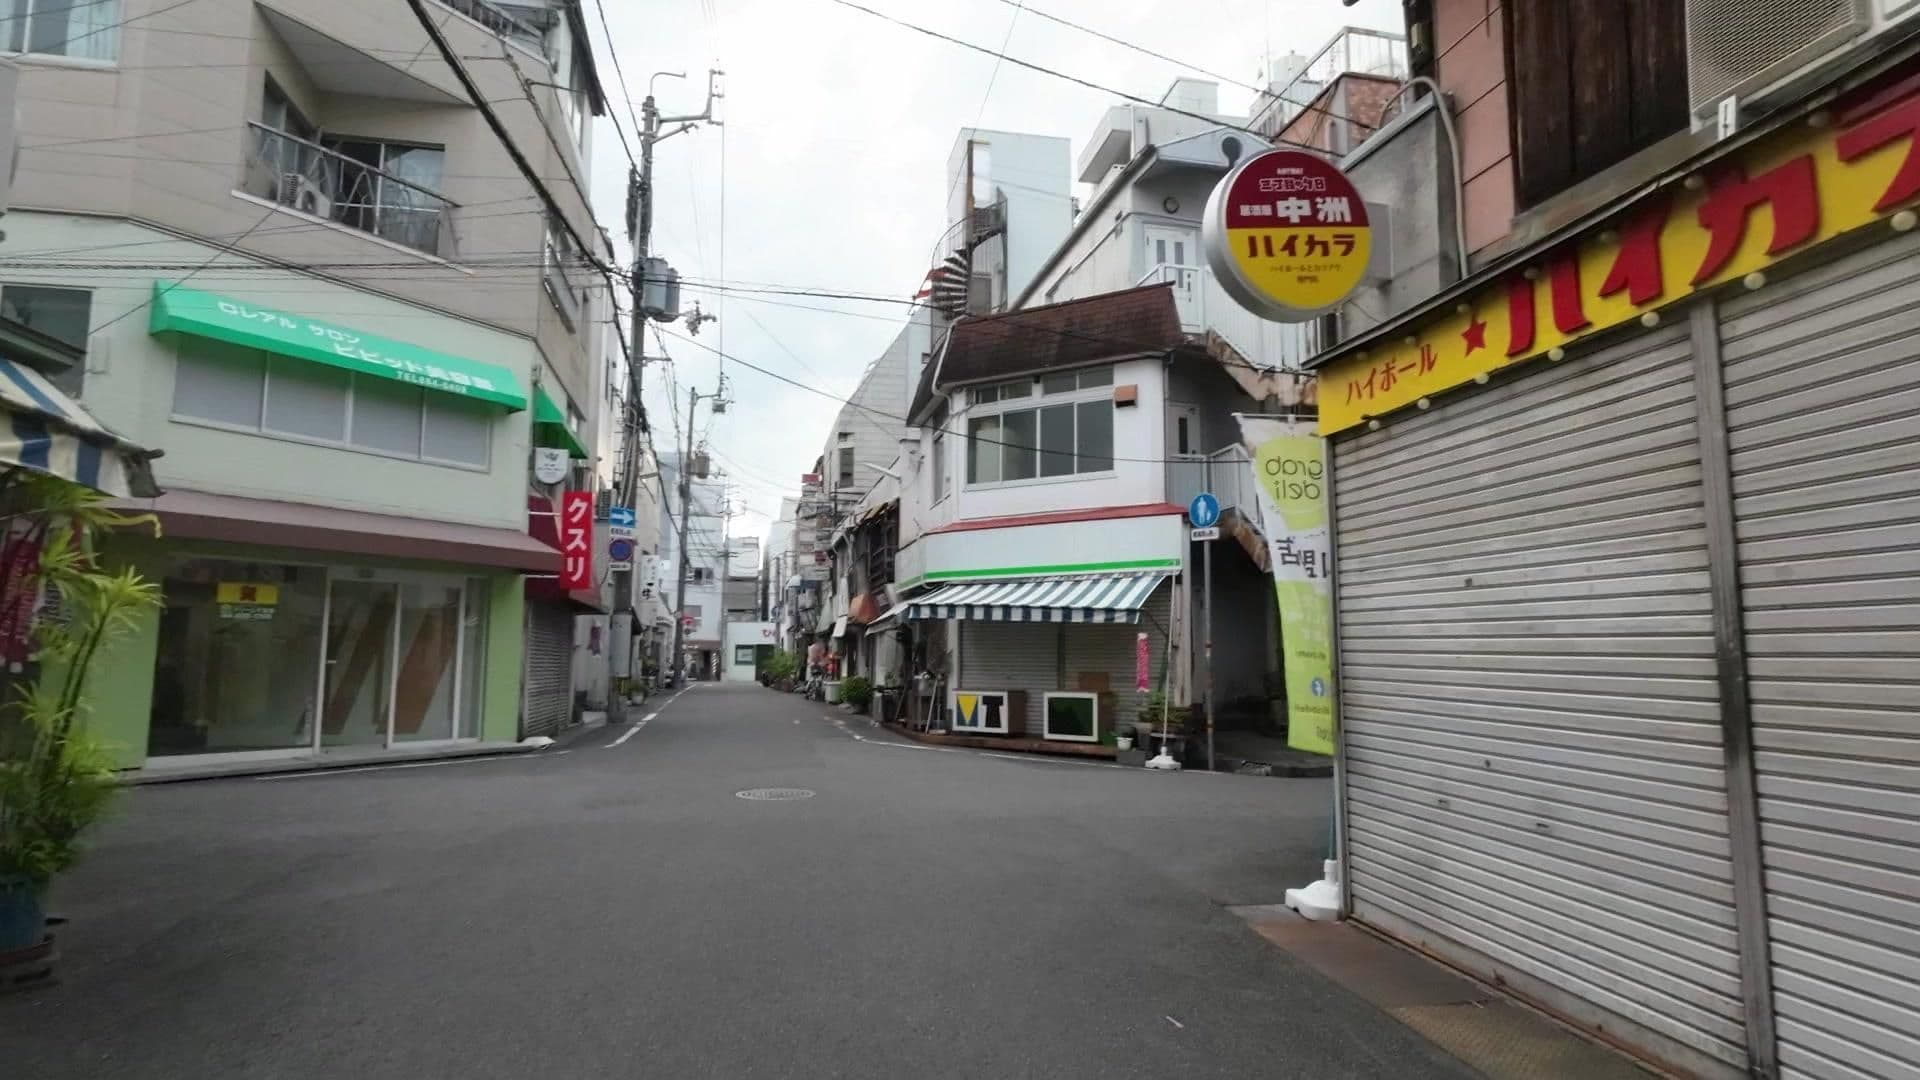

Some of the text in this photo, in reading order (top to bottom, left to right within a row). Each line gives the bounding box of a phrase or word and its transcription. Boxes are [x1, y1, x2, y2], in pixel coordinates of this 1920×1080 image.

[1276, 196, 1352, 223] 中洲
[1247, 234, 1356, 258] ハイカラ
[1344, 72, 1920, 405] ハイボール ハイカラ
[217, 301, 361, 345] ロレアル サロン
[566, 498, 588, 582] クスリ
